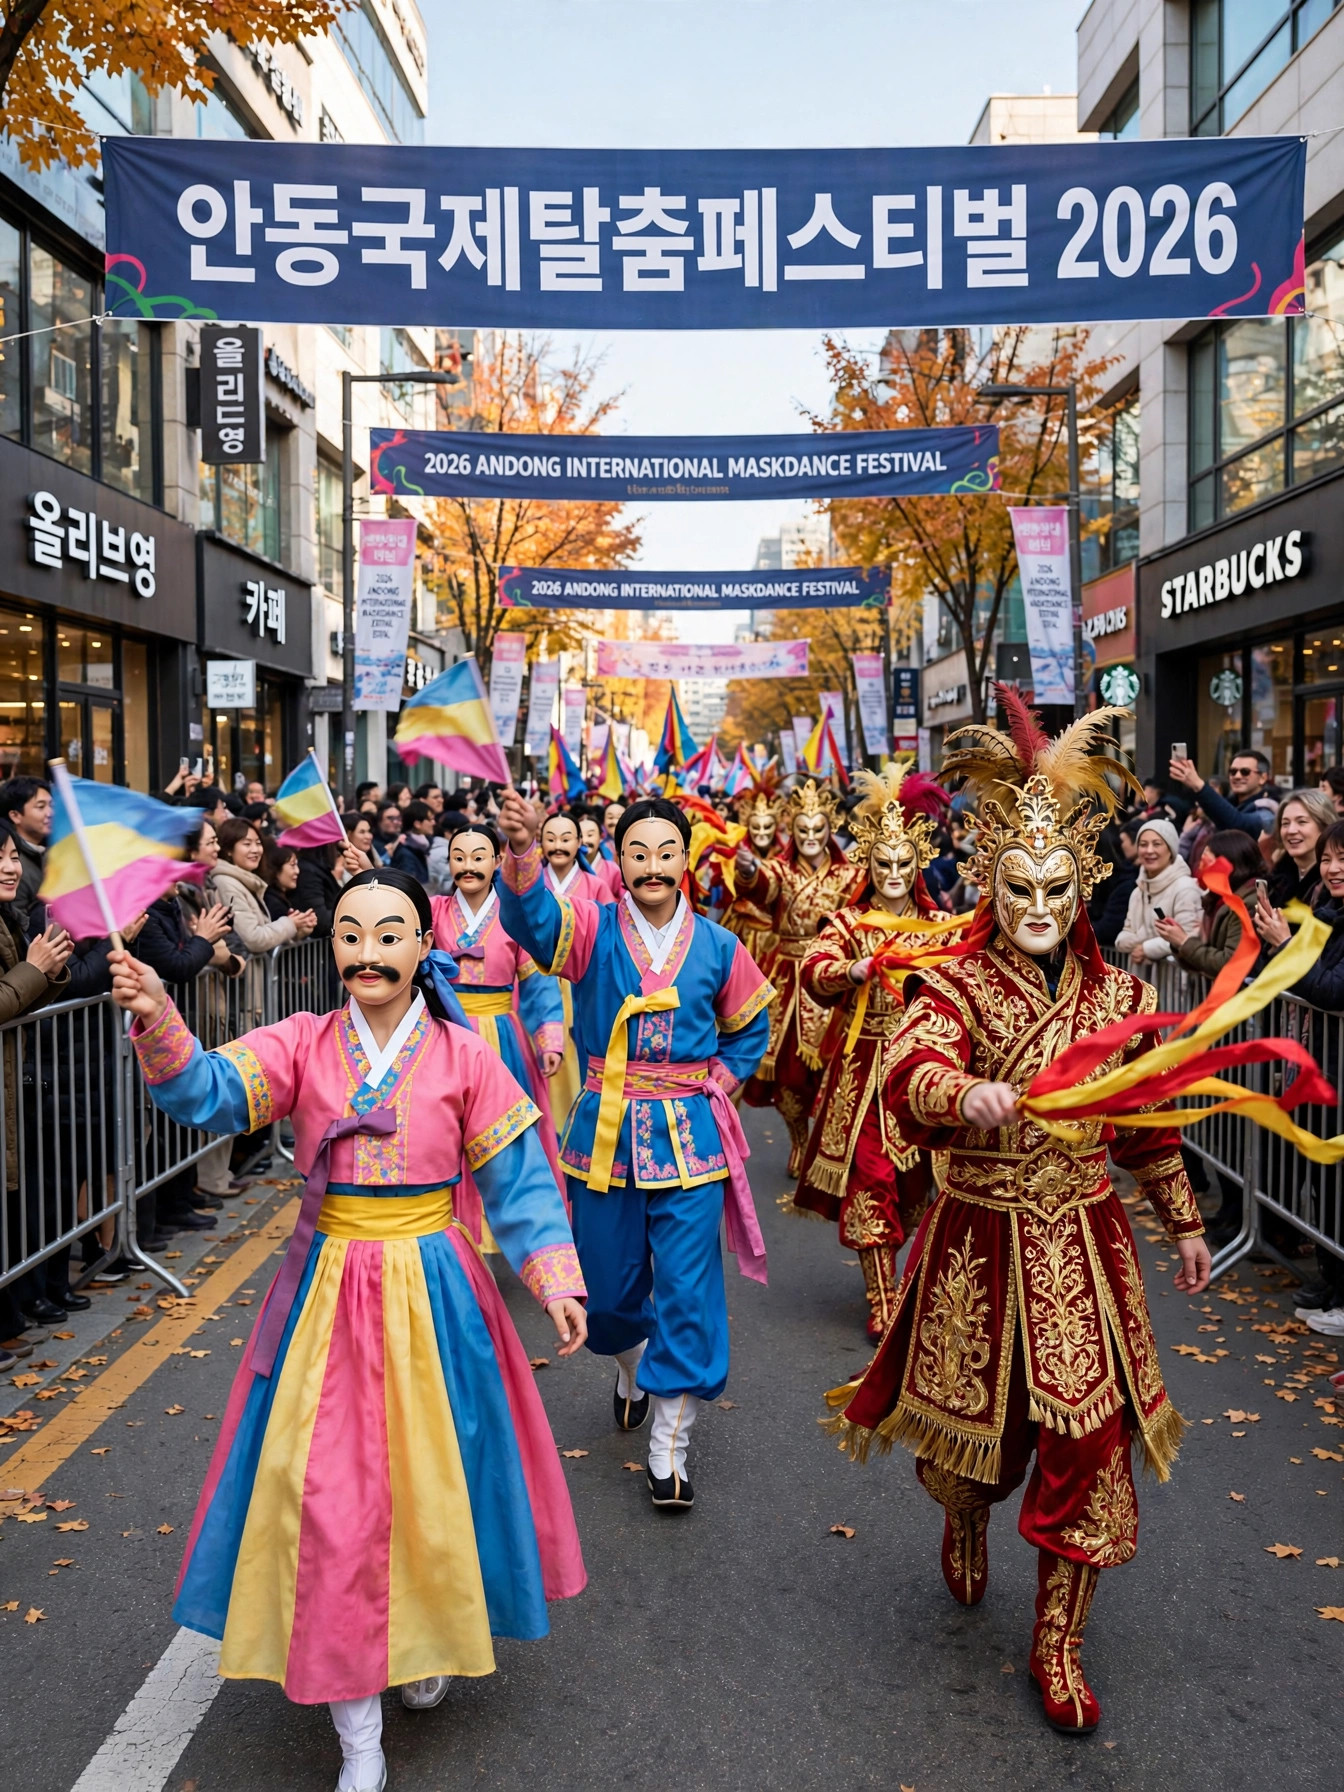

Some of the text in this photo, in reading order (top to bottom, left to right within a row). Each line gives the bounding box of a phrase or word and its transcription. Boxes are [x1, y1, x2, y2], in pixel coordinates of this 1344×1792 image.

[177, 180, 1029, 292] 안동국제탈춤페스티벌
[1056, 181, 1238, 279] 2026
[424, 451, 947, 479] 2026 ANDONG INTERNATIONAL MASKDANCE FESTIVAL
[29, 491, 156, 598] 올리브영
[1161, 530, 1302, 619] STARBUCKS
[246, 580, 286, 645] 카페
[531, 580, 860, 599] 2026 ANDONG INTERNATIONAL MASKDANCE FESTIVAL
